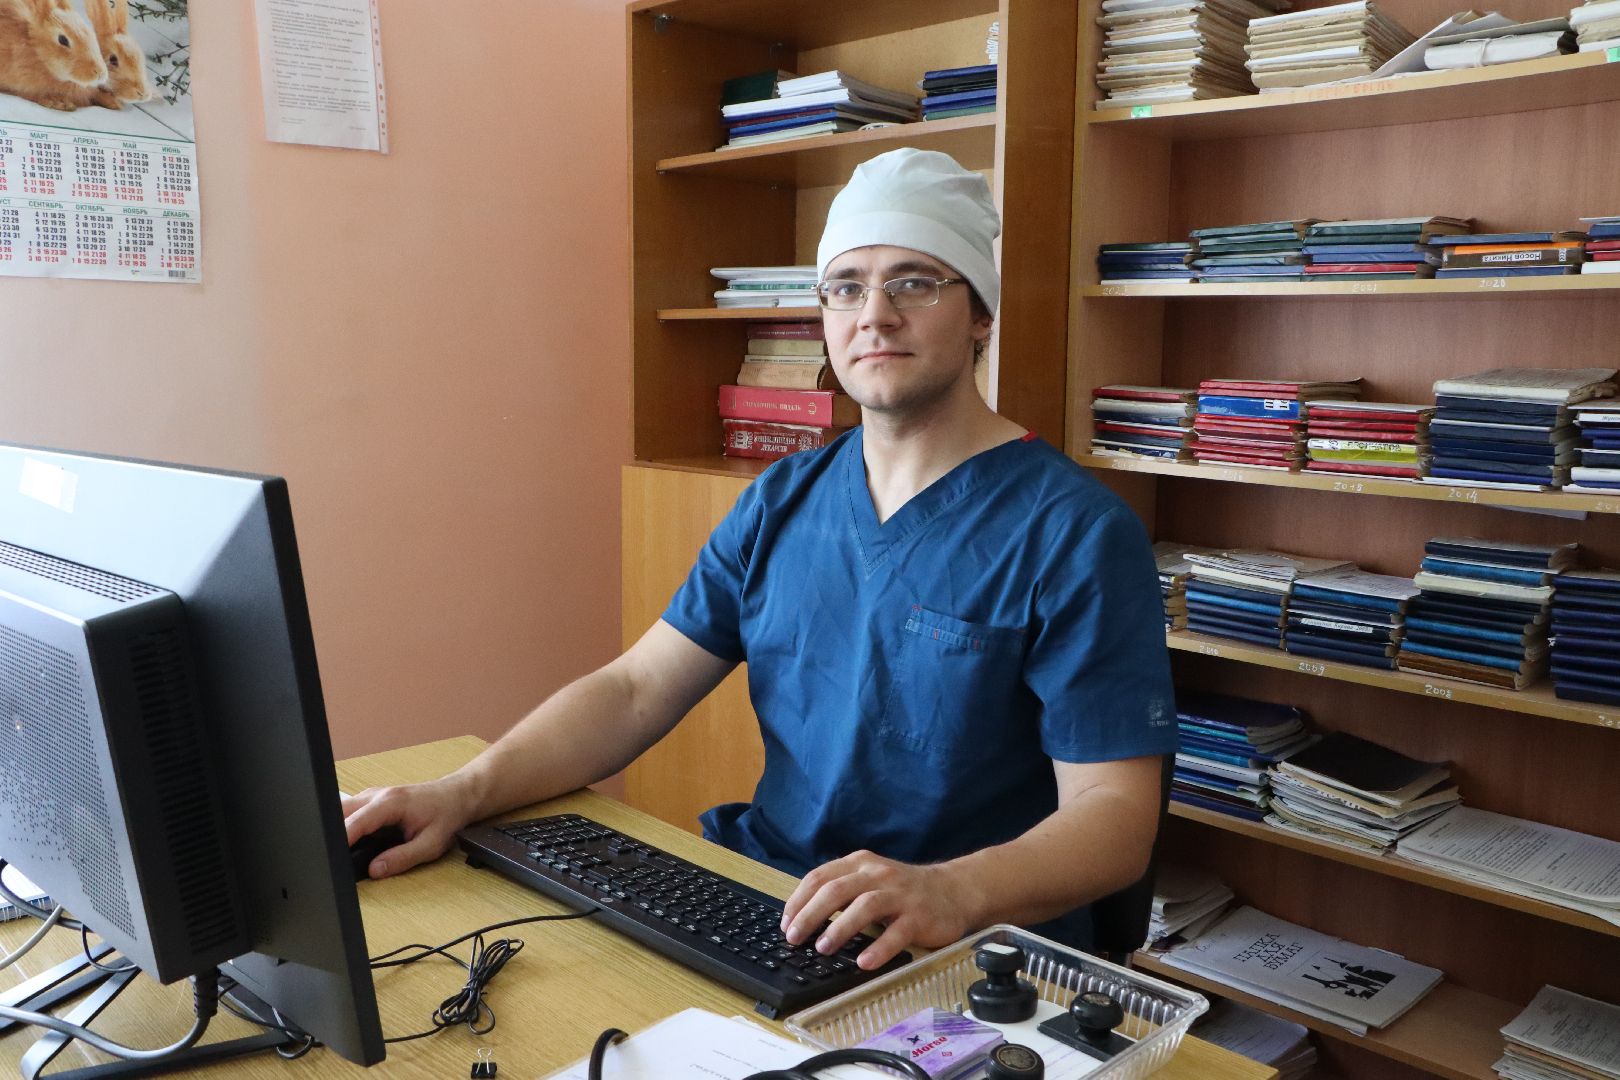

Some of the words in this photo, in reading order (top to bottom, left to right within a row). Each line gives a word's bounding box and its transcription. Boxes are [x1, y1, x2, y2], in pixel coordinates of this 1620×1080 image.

[30, 132, 48, 140] МАРТ
[73, 137, 98, 145] АПРЕЛЬ
[29, 201, 64, 209] СЕНТЯБРЬ
[1334, 482, 1363, 491] 2015
[1448, 488, 1477, 503] 2014
[1233, 933, 1280, 962] ПАПКА
[1256, 943, 1285, 962] ДЛЯ
[1264, 942, 1304, 970] БУМАГ
